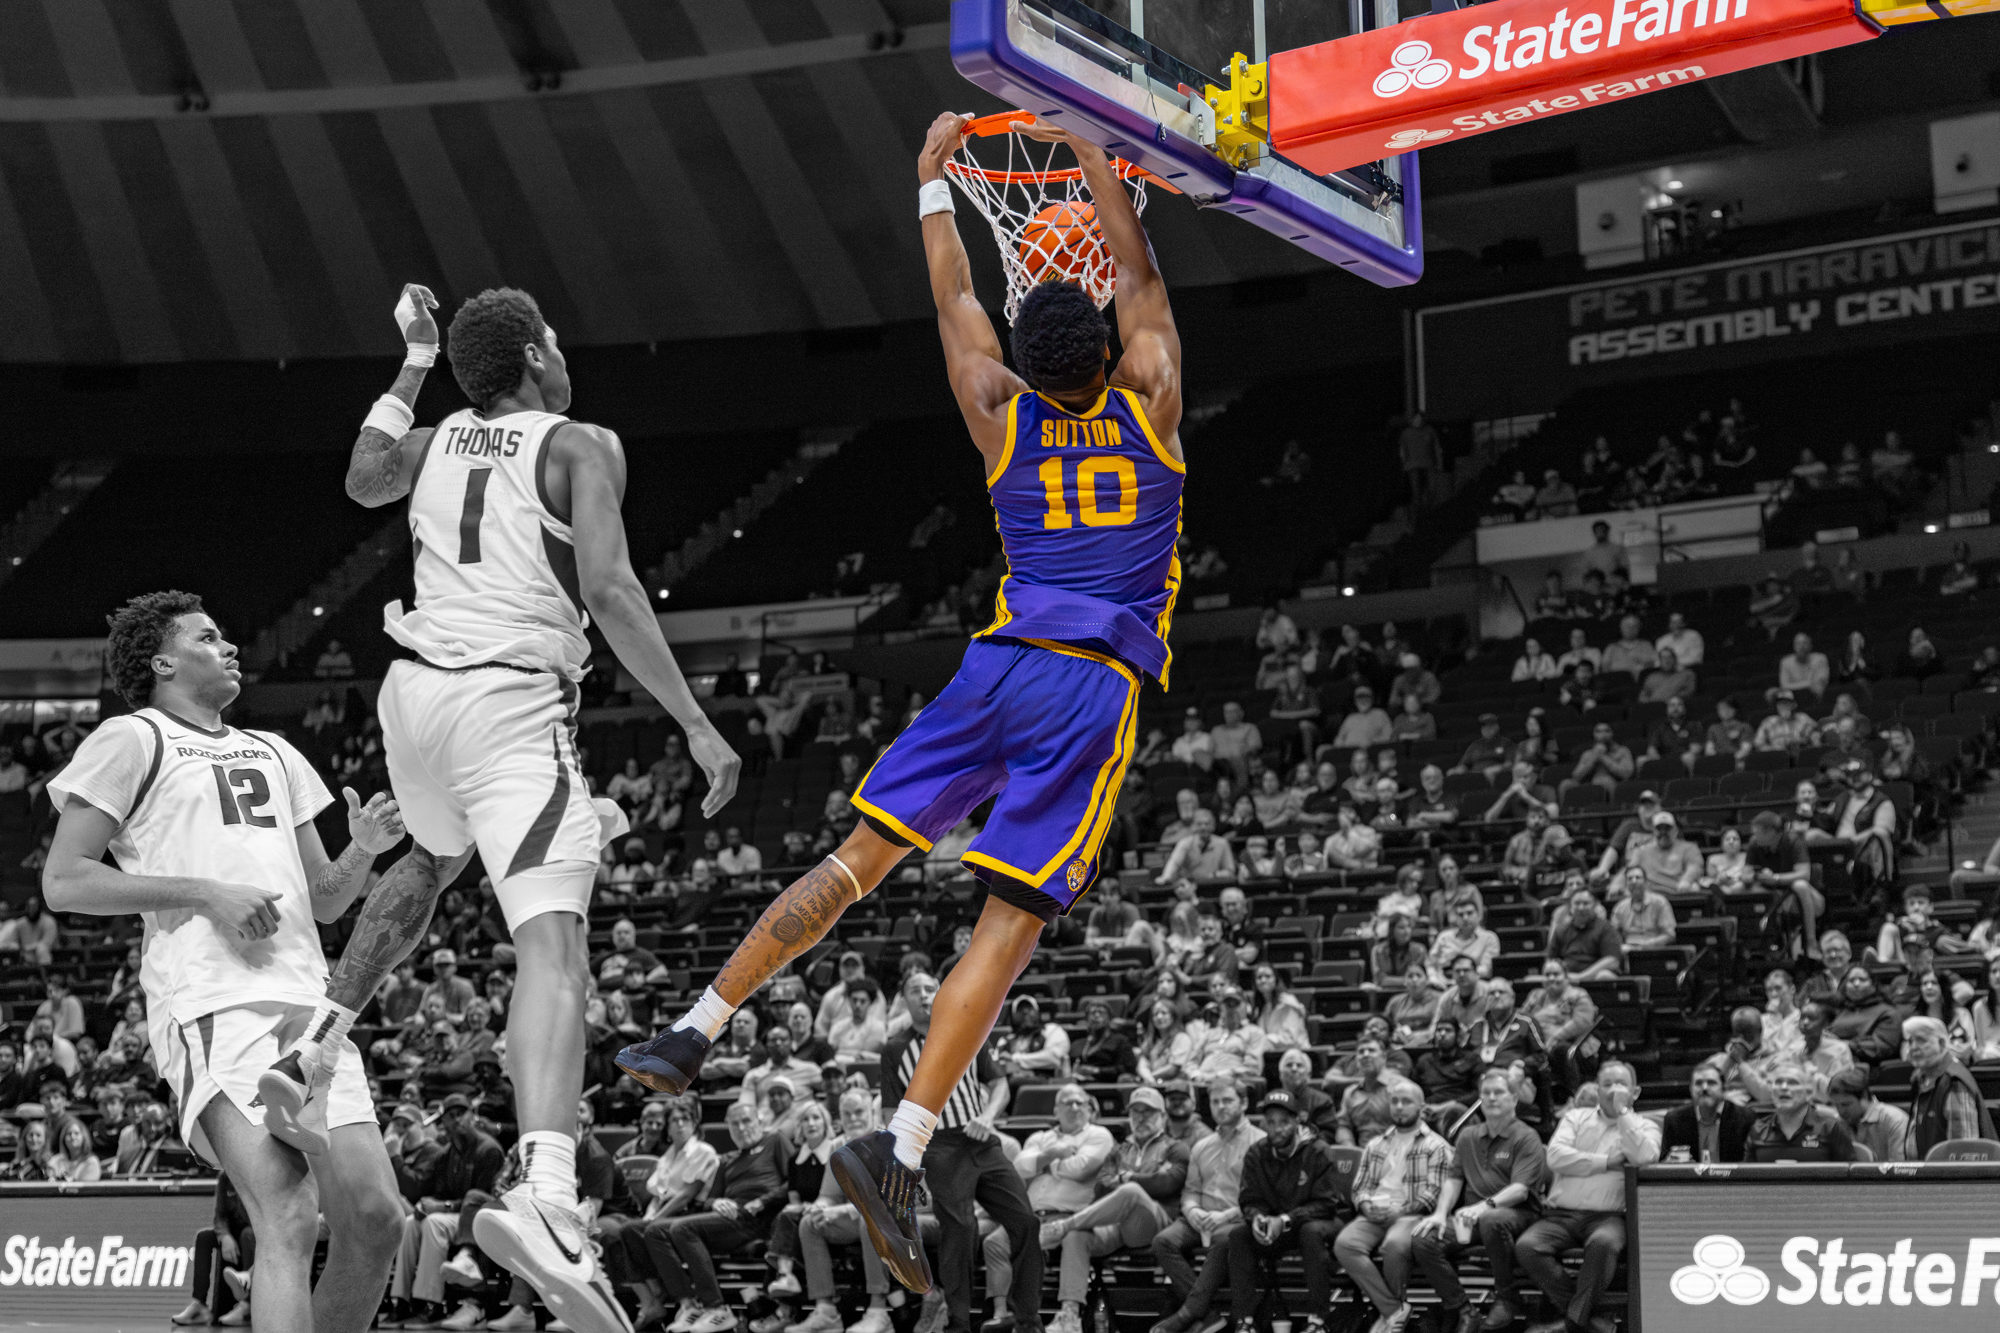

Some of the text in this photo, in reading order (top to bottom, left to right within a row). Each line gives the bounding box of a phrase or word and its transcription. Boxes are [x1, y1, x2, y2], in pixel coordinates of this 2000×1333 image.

[1569, 276, 1708, 327] PETE
[1569, 274, 2000, 365] ASSEMBLY CENTE
[1041, 418, 1122, 447] SUTTON
[458, 468, 493, 564] 1
[1038, 455, 1139, 529] 10
[211, 764, 277, 828] 12
[792, 901, 815, 923] AMEN
[1269, 1093, 1289, 1103] YETI
